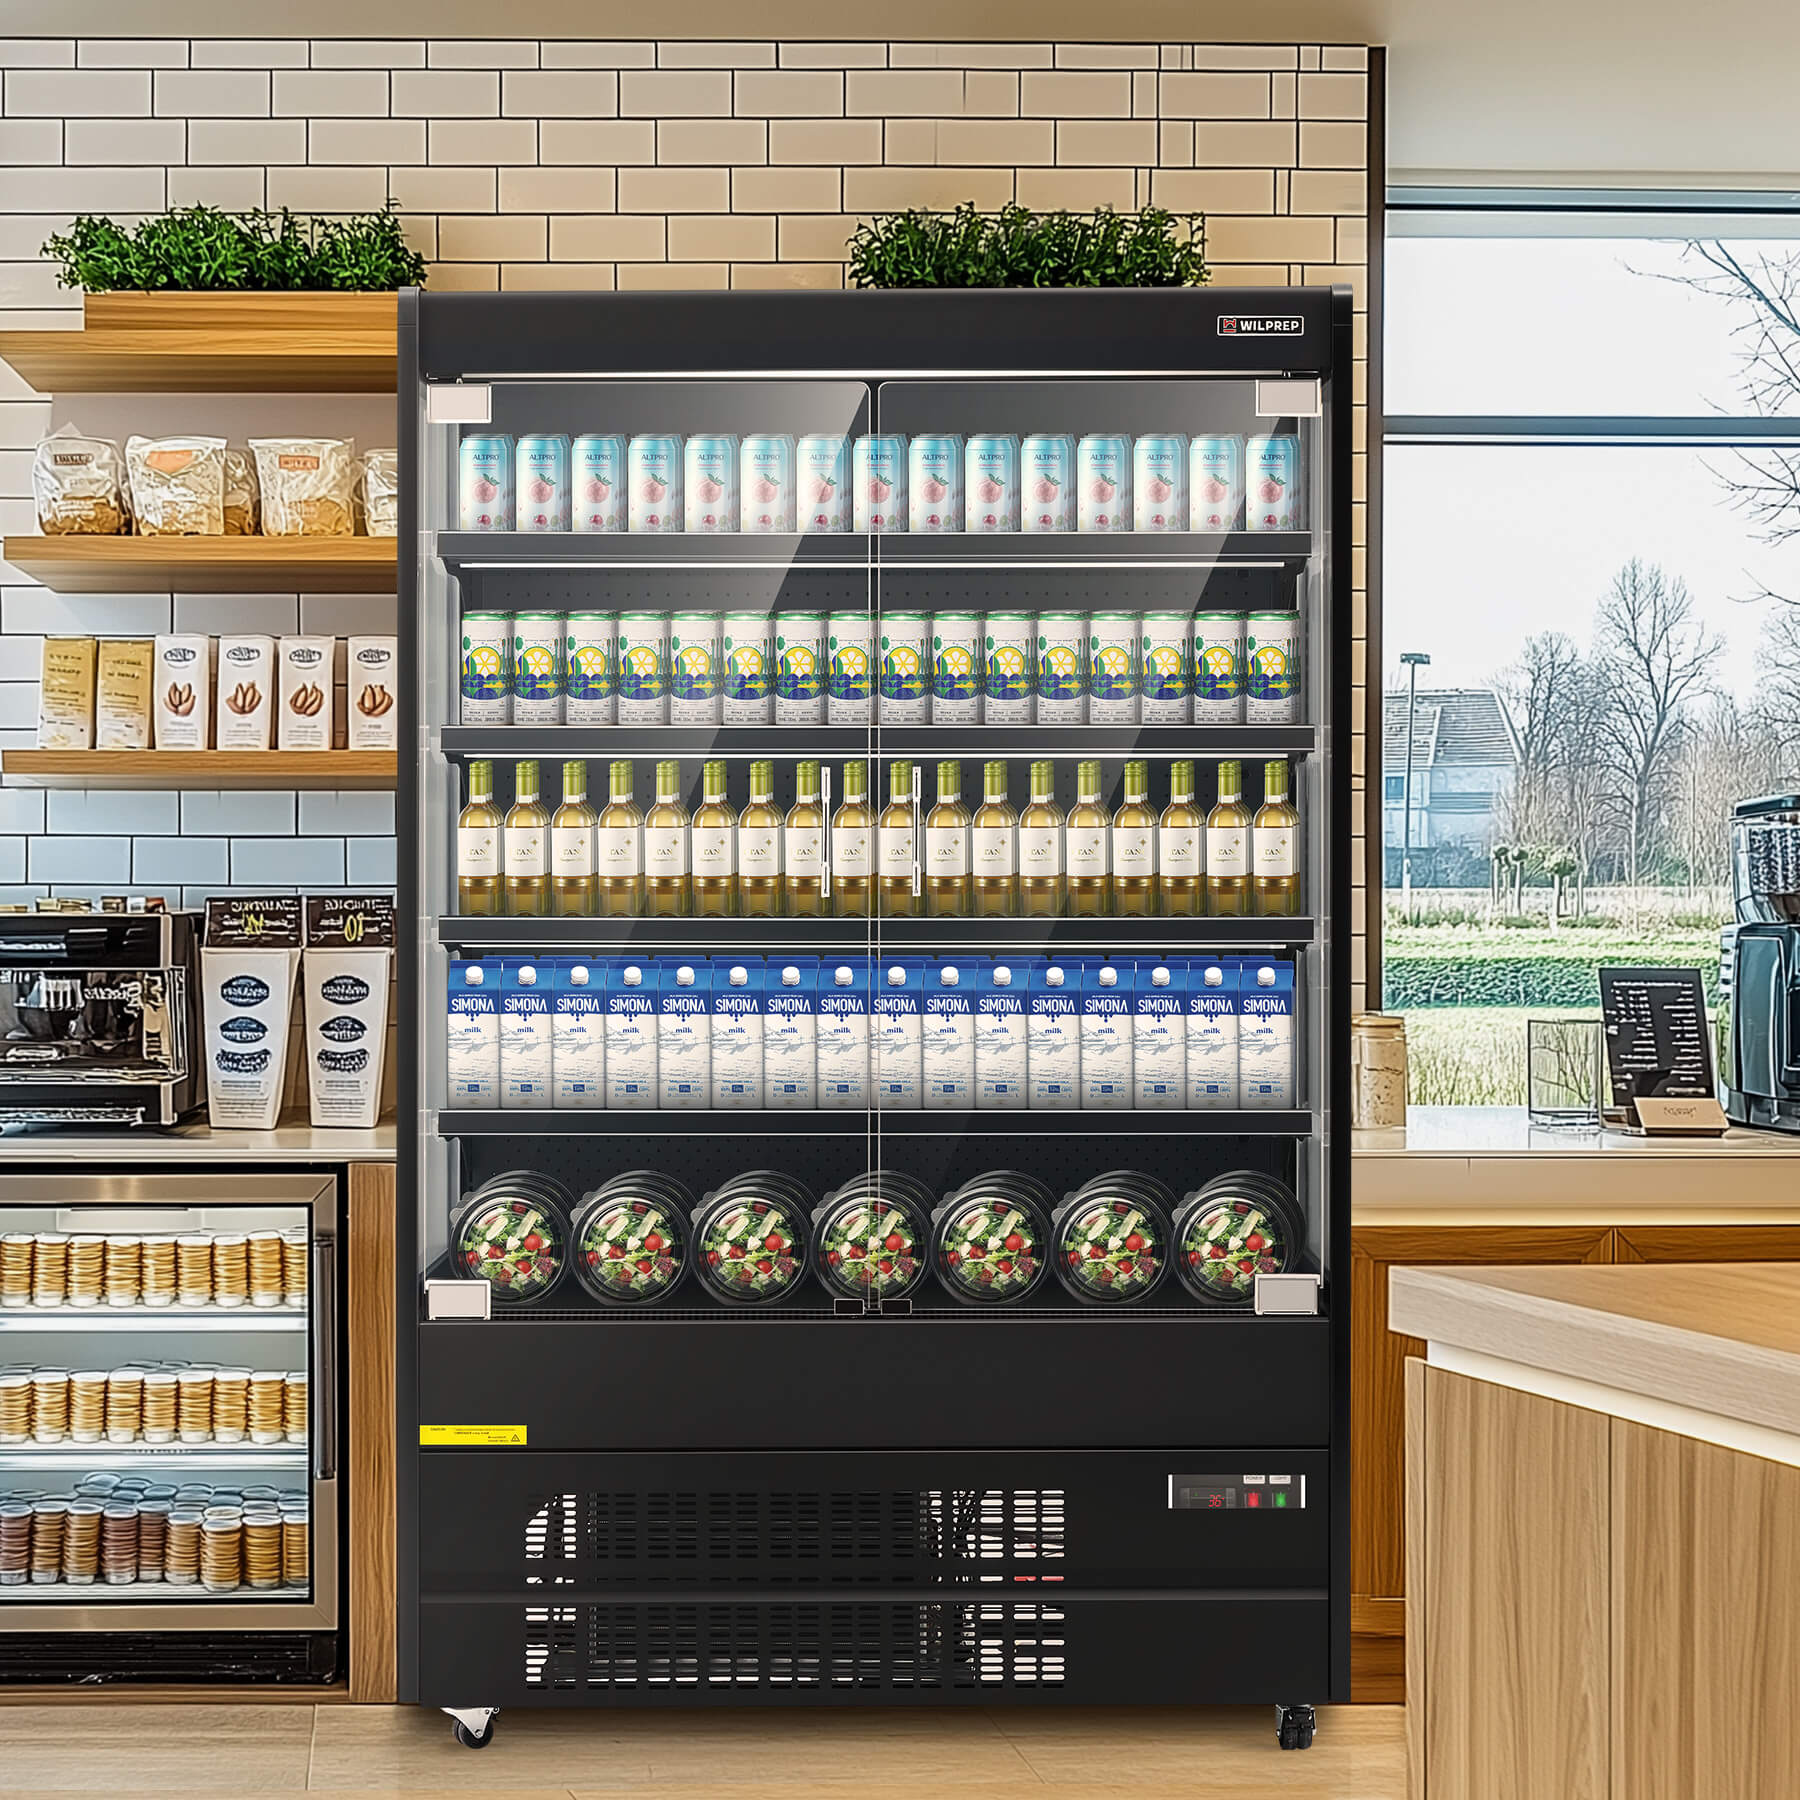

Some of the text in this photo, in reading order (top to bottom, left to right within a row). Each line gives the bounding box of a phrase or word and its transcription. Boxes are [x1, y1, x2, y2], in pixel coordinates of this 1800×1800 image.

[1240, 320, 1299, 331] WILPREP
[451, 998, 495, 1012] SIMONA
[504, 998, 548, 1012] SIMONA
[556, 998, 600, 1012] SIMONA
[609, 998, 653, 1012] SIMONA
[662, 998, 706, 1012] SIMONA
[715, 998, 759, 1012] SIMONA
[768, 999, 812, 1013] SIMONA
[820, 998, 864, 1012] SIMONA
[873, 998, 917, 1012] SIMONA
[926, 998, 970, 1012] SIMONA
[979, 999, 1023, 1013] SIMONA
[1032, 999, 1076, 1013] SIMONA
[1085, 999, 1129, 1013] SIMONA
[1138, 999, 1182, 1013] SIMONA
[1190, 999, 1234, 1013] SIMONA
[1243, 999, 1287, 1013] SIMONA
